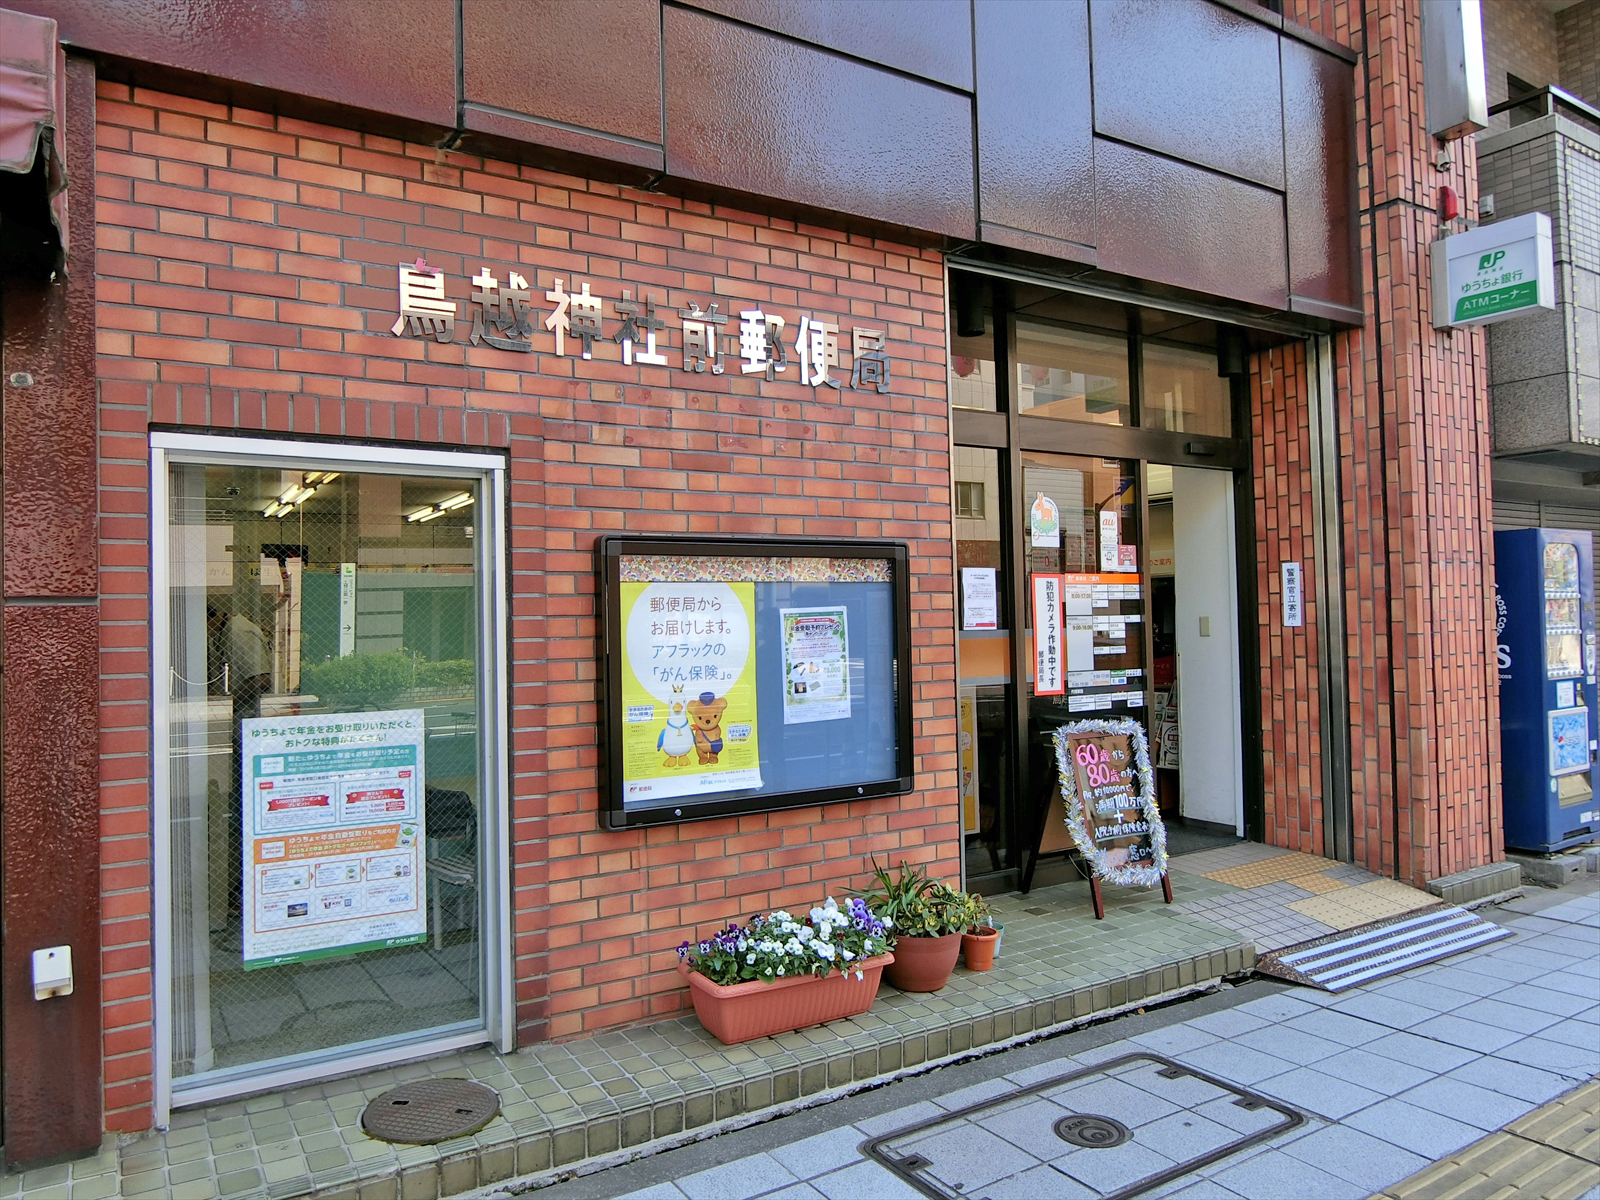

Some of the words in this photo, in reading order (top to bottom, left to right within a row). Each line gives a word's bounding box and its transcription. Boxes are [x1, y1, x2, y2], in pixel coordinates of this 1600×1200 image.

[1479, 250, 1506, 270] JP
[1461, 269, 1523, 293] ゆうちょ銀行
[1477, 266, 1504, 276] BANK
[1463, 289, 1530, 310] ATMコーナー
[391, 261, 890, 394] 鳥越神社前郵便局
[650, 596, 722, 613] 郵便局から
[1286, 568, 1297, 621] 警察官立寄所
[650, 619, 732, 636] お届けします。
[1045, 580, 1056, 688] 防犯カメラ作動中です
[652, 643, 726, 659] アフラックの
[653, 664, 732, 682] 「がん保険」。
[1037, 650, 1045, 683] 郵便局長
[251, 720, 417, 738] ゆうちょで年金をお受け取りいただくと、
[1076, 744, 1125, 767] 60歳から
[1086, 763, 1139, 788] 80歳の方へ
